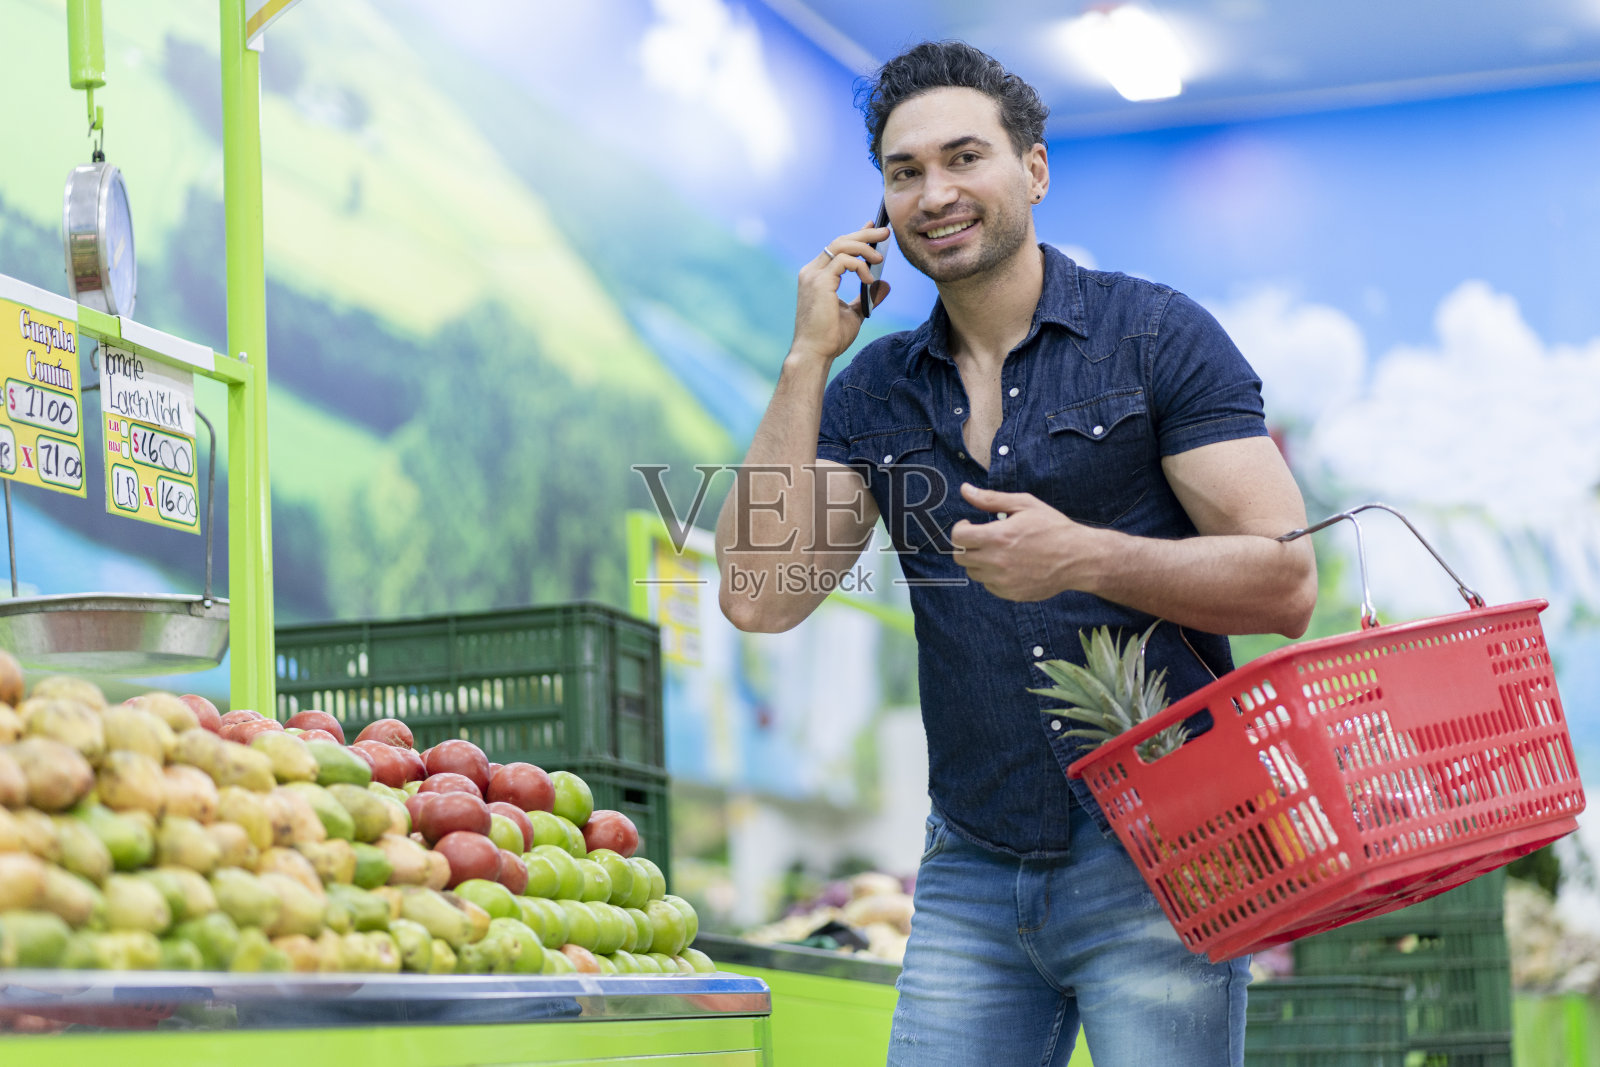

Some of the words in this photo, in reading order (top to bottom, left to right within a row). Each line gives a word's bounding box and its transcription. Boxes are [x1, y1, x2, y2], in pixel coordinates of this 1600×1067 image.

[19, 308, 76, 354] Guayaba
[26, 349, 73, 390] Común
[116, 471, 138, 509] LB
[161, 480, 199, 518] 1600
